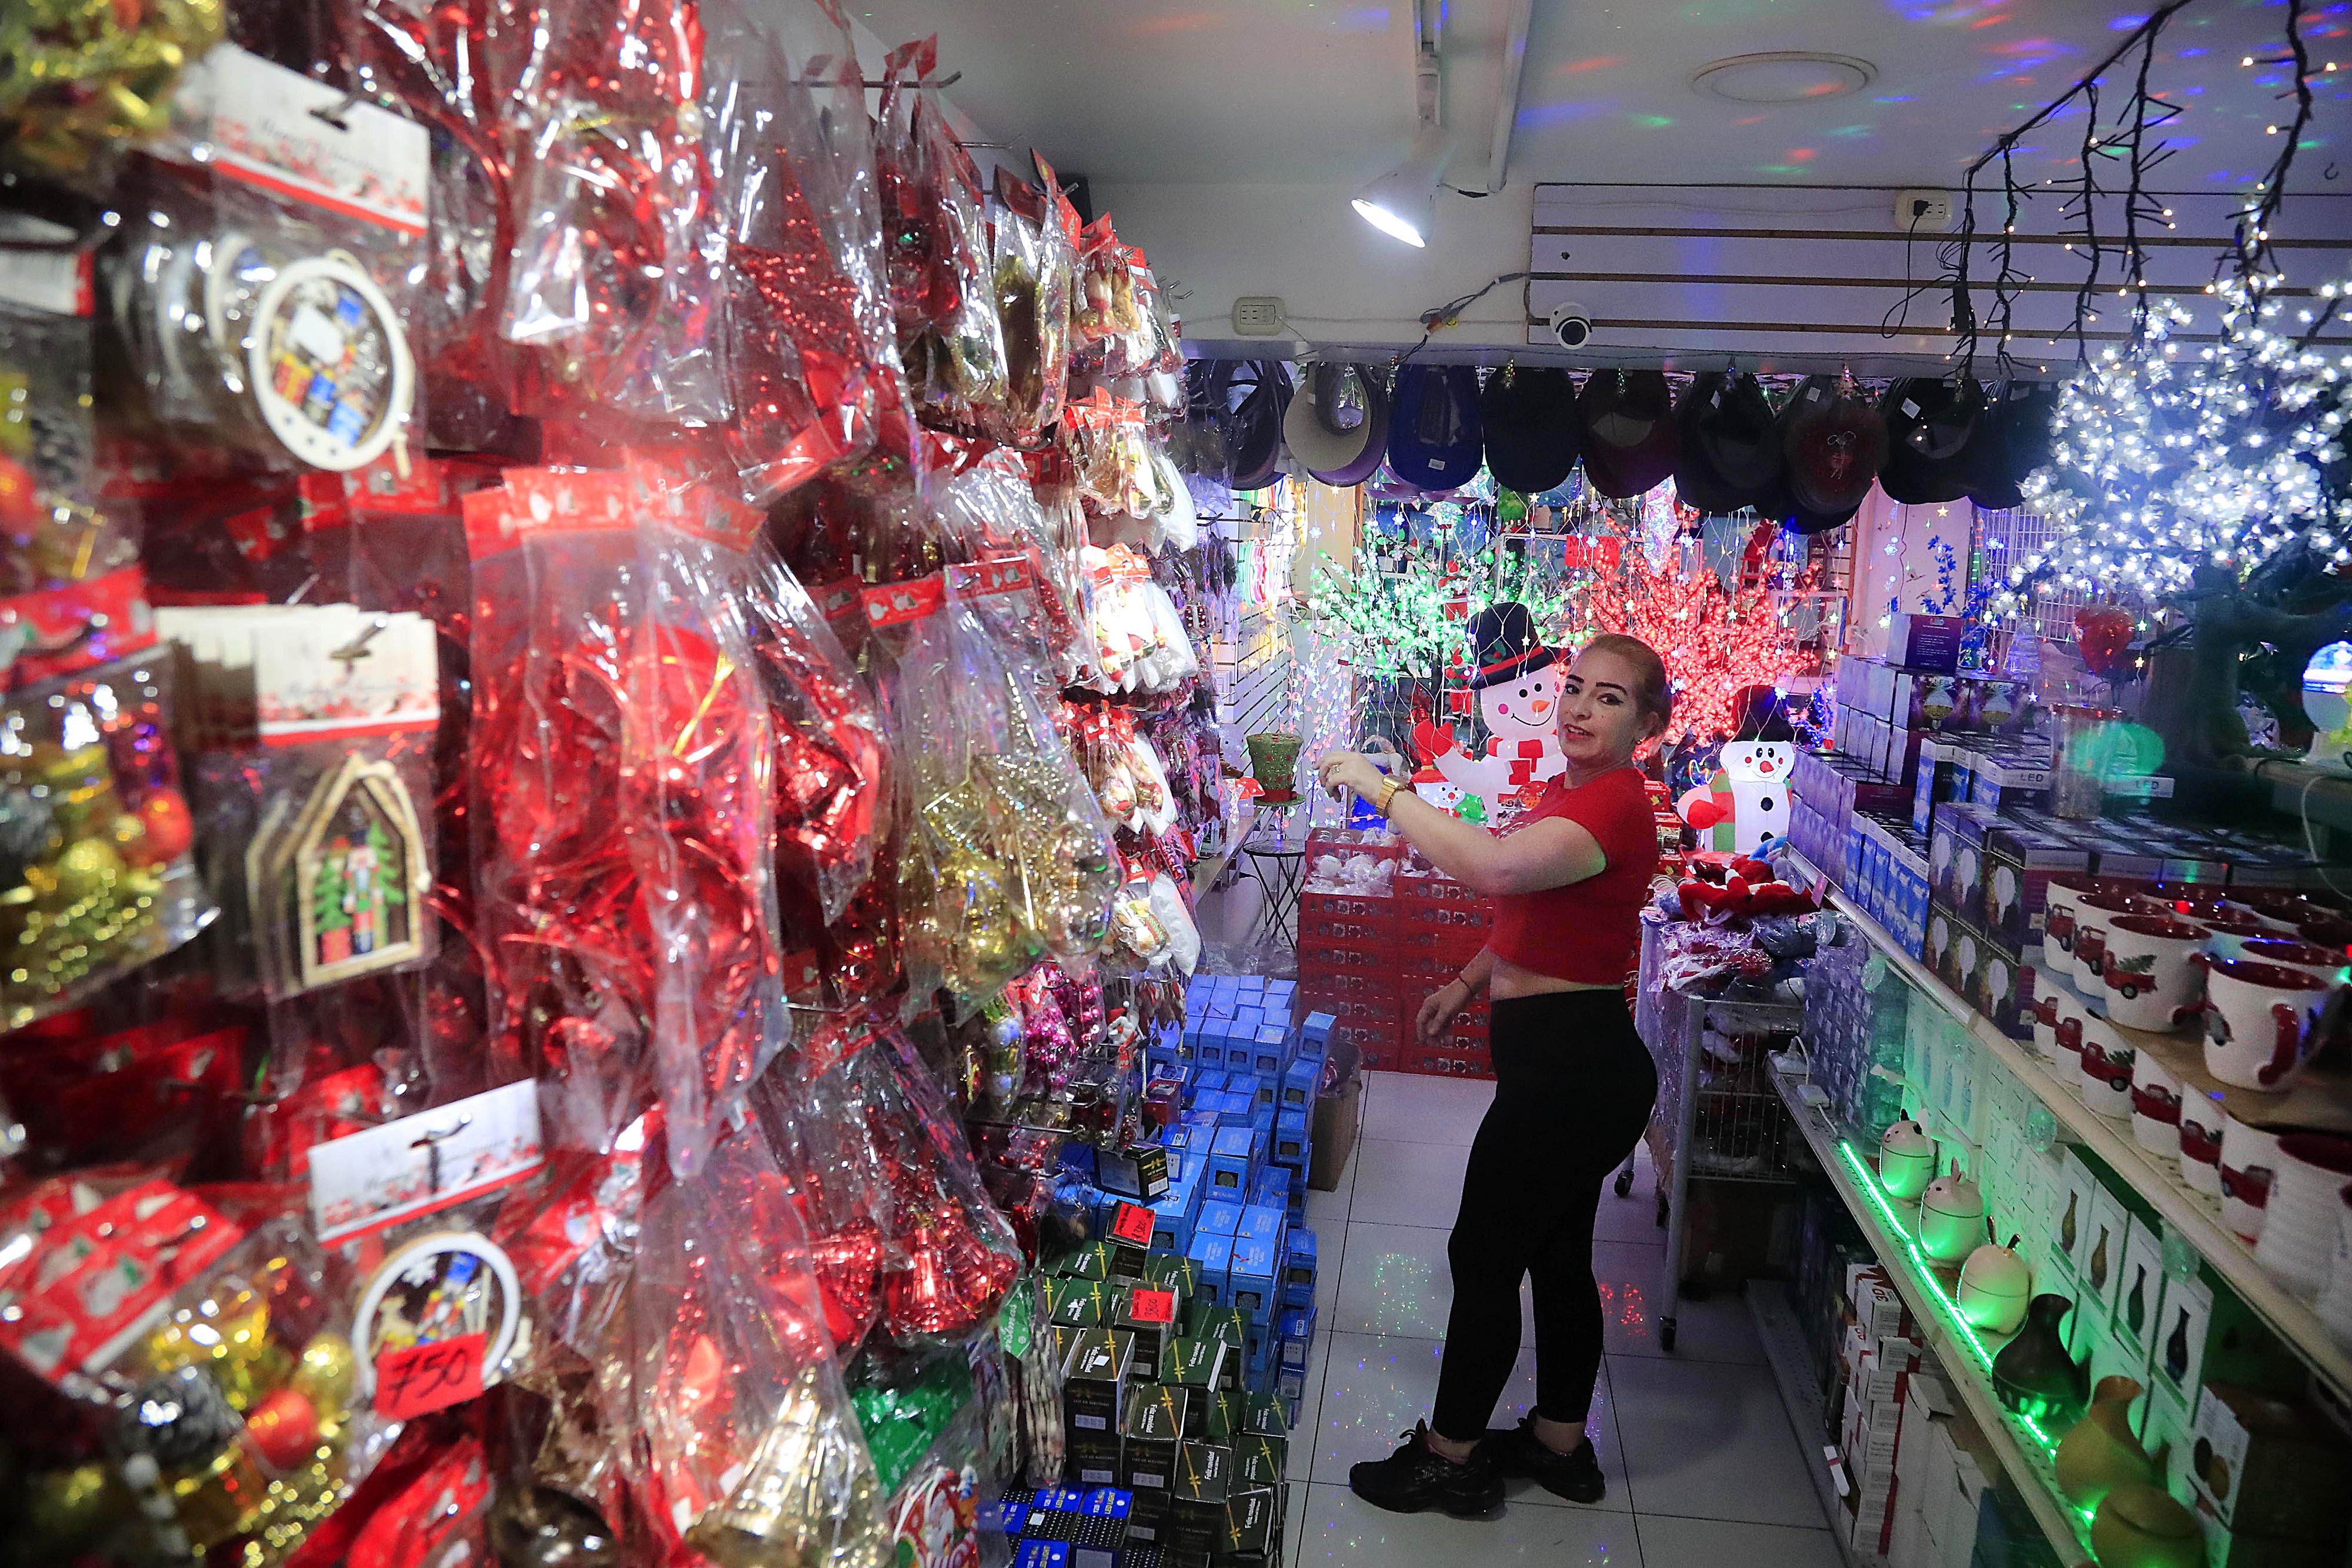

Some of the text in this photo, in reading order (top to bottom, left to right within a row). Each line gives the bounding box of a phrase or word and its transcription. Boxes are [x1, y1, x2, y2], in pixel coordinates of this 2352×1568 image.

[2021, 773, 2044, 783] LED
[2136, 780, 2159, 790] LED
[1078, 1298, 1087, 1307] Feliz
[1090, 1346, 1100, 1358] Feliz
[1192, 1342, 1201, 1357] navidad
[1084, 1355, 1095, 1373] navidad
[1188, 1357, 1197, 1367] Feliz
[387, 1348, 468, 1409] 750
[1145, 1404, 1158, 1433] Feliz navidad
[1207, 1451, 1215, 1469] navidad
[1055, 1499, 1063, 1508] LED
[1107, 1492, 1115, 1505] LIGHT
[1245, 1516, 1253, 1528] Feliz
